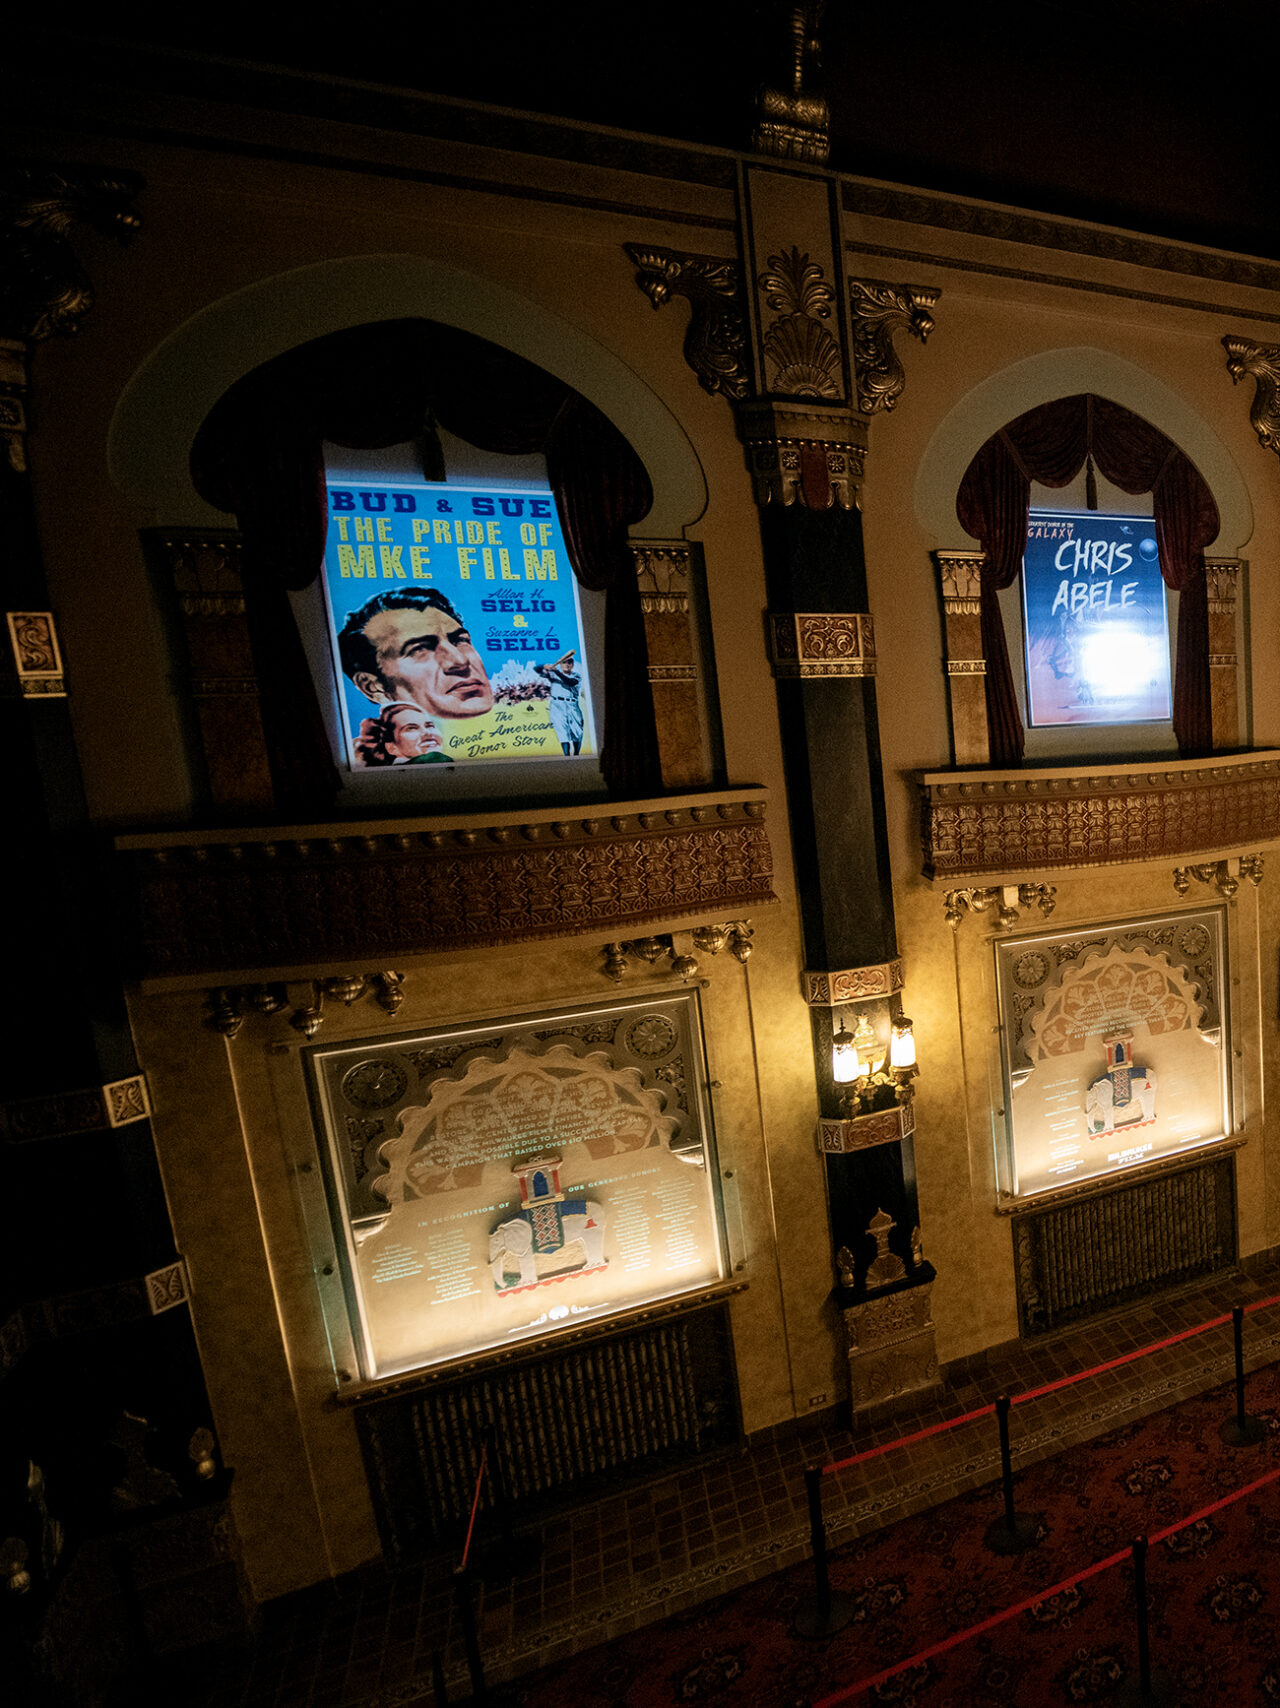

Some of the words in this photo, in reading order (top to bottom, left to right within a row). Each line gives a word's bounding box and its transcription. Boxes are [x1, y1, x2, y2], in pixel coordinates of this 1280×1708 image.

[330, 491, 416, 513] BUD
[437, 499, 453, 513] &
[472, 497, 551, 518] SUE
[333, 516, 393, 542] THE
[412, 519, 503, 545] PRIDE
[520, 523, 552, 546] OF
[1027, 527, 1074, 541] GALAXY
[337, 545, 432, 579] MKE
[457, 547, 558, 581] FILM
[1055, 538, 1133, 578] CHRIS
[481, 600, 555, 612] SELIG
[488, 588, 524, 599] Allan
[1051, 579, 1139, 616] ABELE
[485, 626, 539, 637] Suzanne
[513, 614, 528, 627] &
[486, 638, 560, 651] SELIG
[495, 711, 513, 722] The
[449, 730, 486, 748] Great
[489, 722, 554, 738] American
[468, 742, 507, 758] Donor
[512, 735, 547, 747] Story
[482, 1131, 527, 1147] MILWAUKEE
[555, 1116, 594, 1131] FINANCIAL
[486, 1125, 517, 1138] CENTER
[519, 1121, 535, 1131] FOR
[537, 1117, 553, 1127] OUR
[555, 1111, 582, 1123] ENTIRE
[446, 1155, 490, 1170] CAMPAIGN
[492, 1150, 512, 1160] THAT
[515, 1144, 542, 1155] RAISED
[545, 1138, 566, 1149] OVER
[568, 1135, 582, 1144] $10
[480, 1141, 518, 1155] POSSIBLE
[521, 1137, 537, 1146] DUE
[540, 1134, 550, 1142] TO
[417, 1218, 427, 1227] IN
[432, 1204, 494, 1224] RECOGNITION
[498, 1201, 509, 1209] OF
[568, 1184, 584, 1193] OUR
